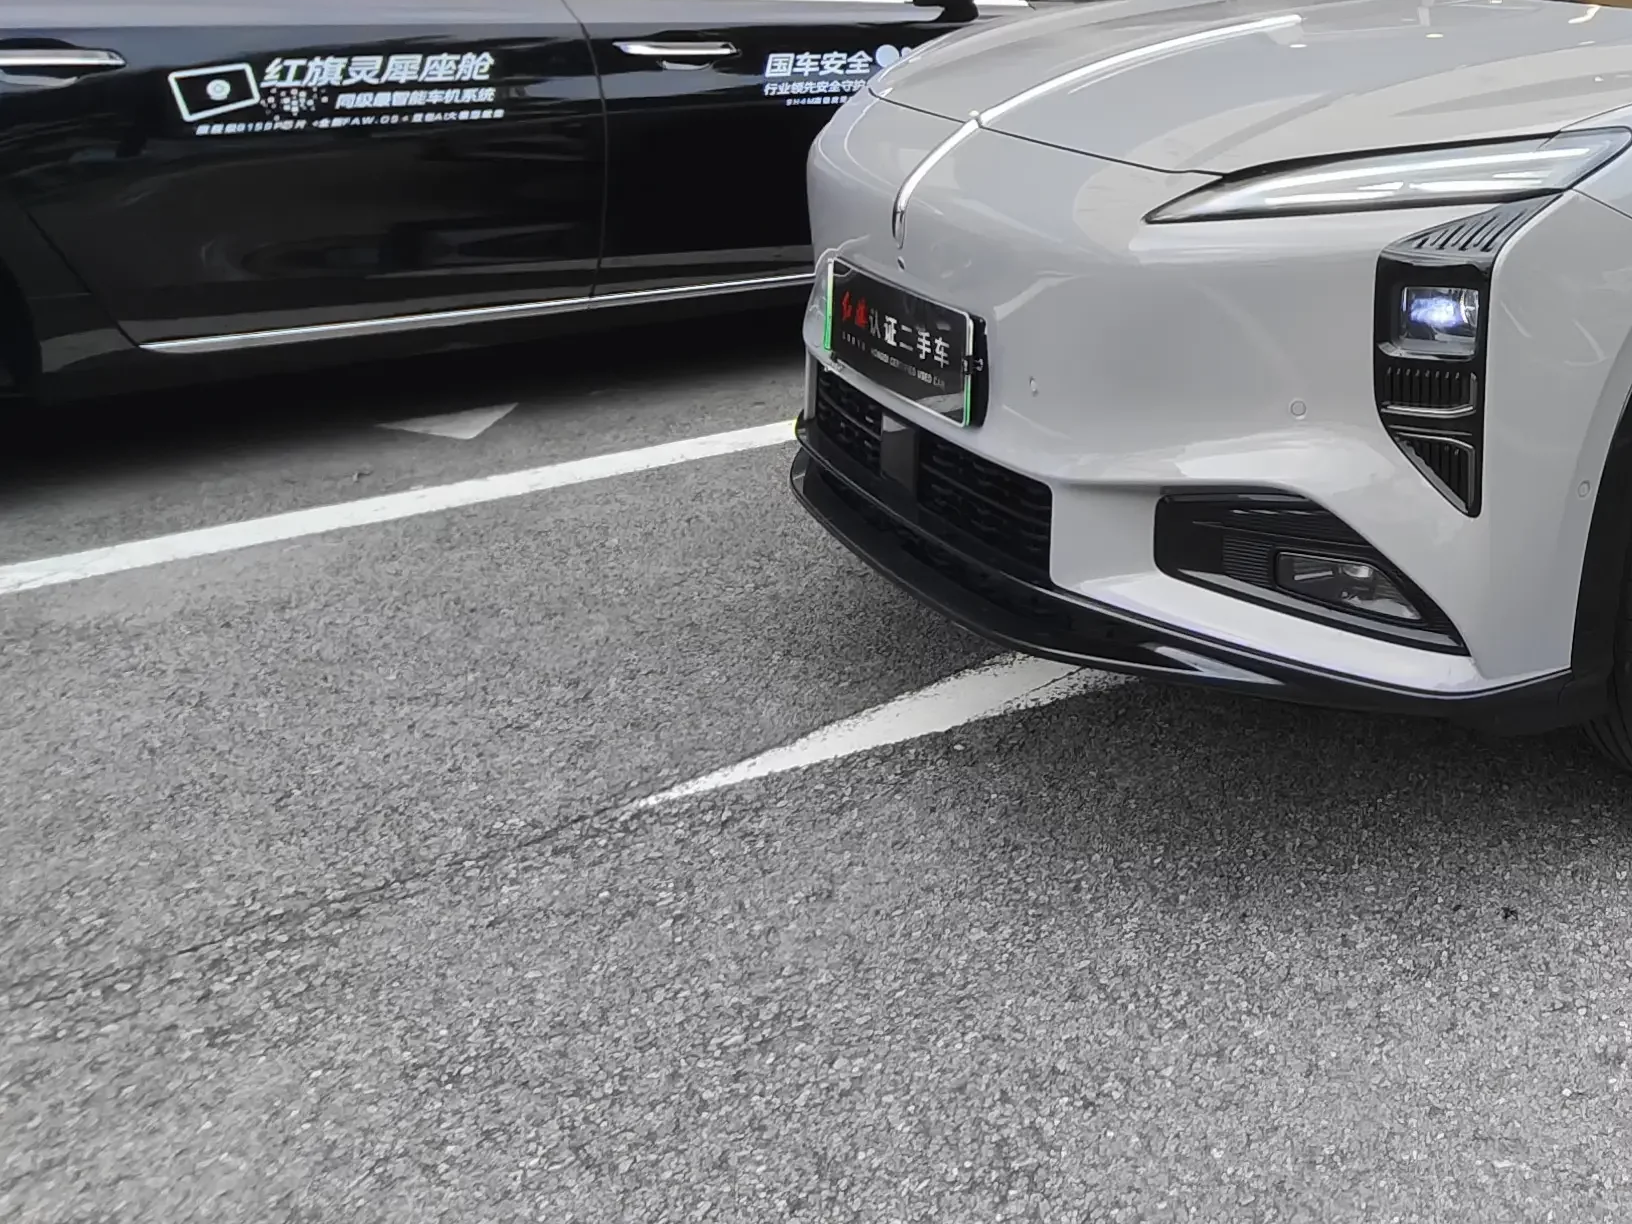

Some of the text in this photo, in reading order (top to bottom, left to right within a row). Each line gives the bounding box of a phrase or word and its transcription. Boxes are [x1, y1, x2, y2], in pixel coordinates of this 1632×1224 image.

[260, 51, 495, 88] 红旗灵犀座舱
[765, 50, 873, 77] 国车安全
